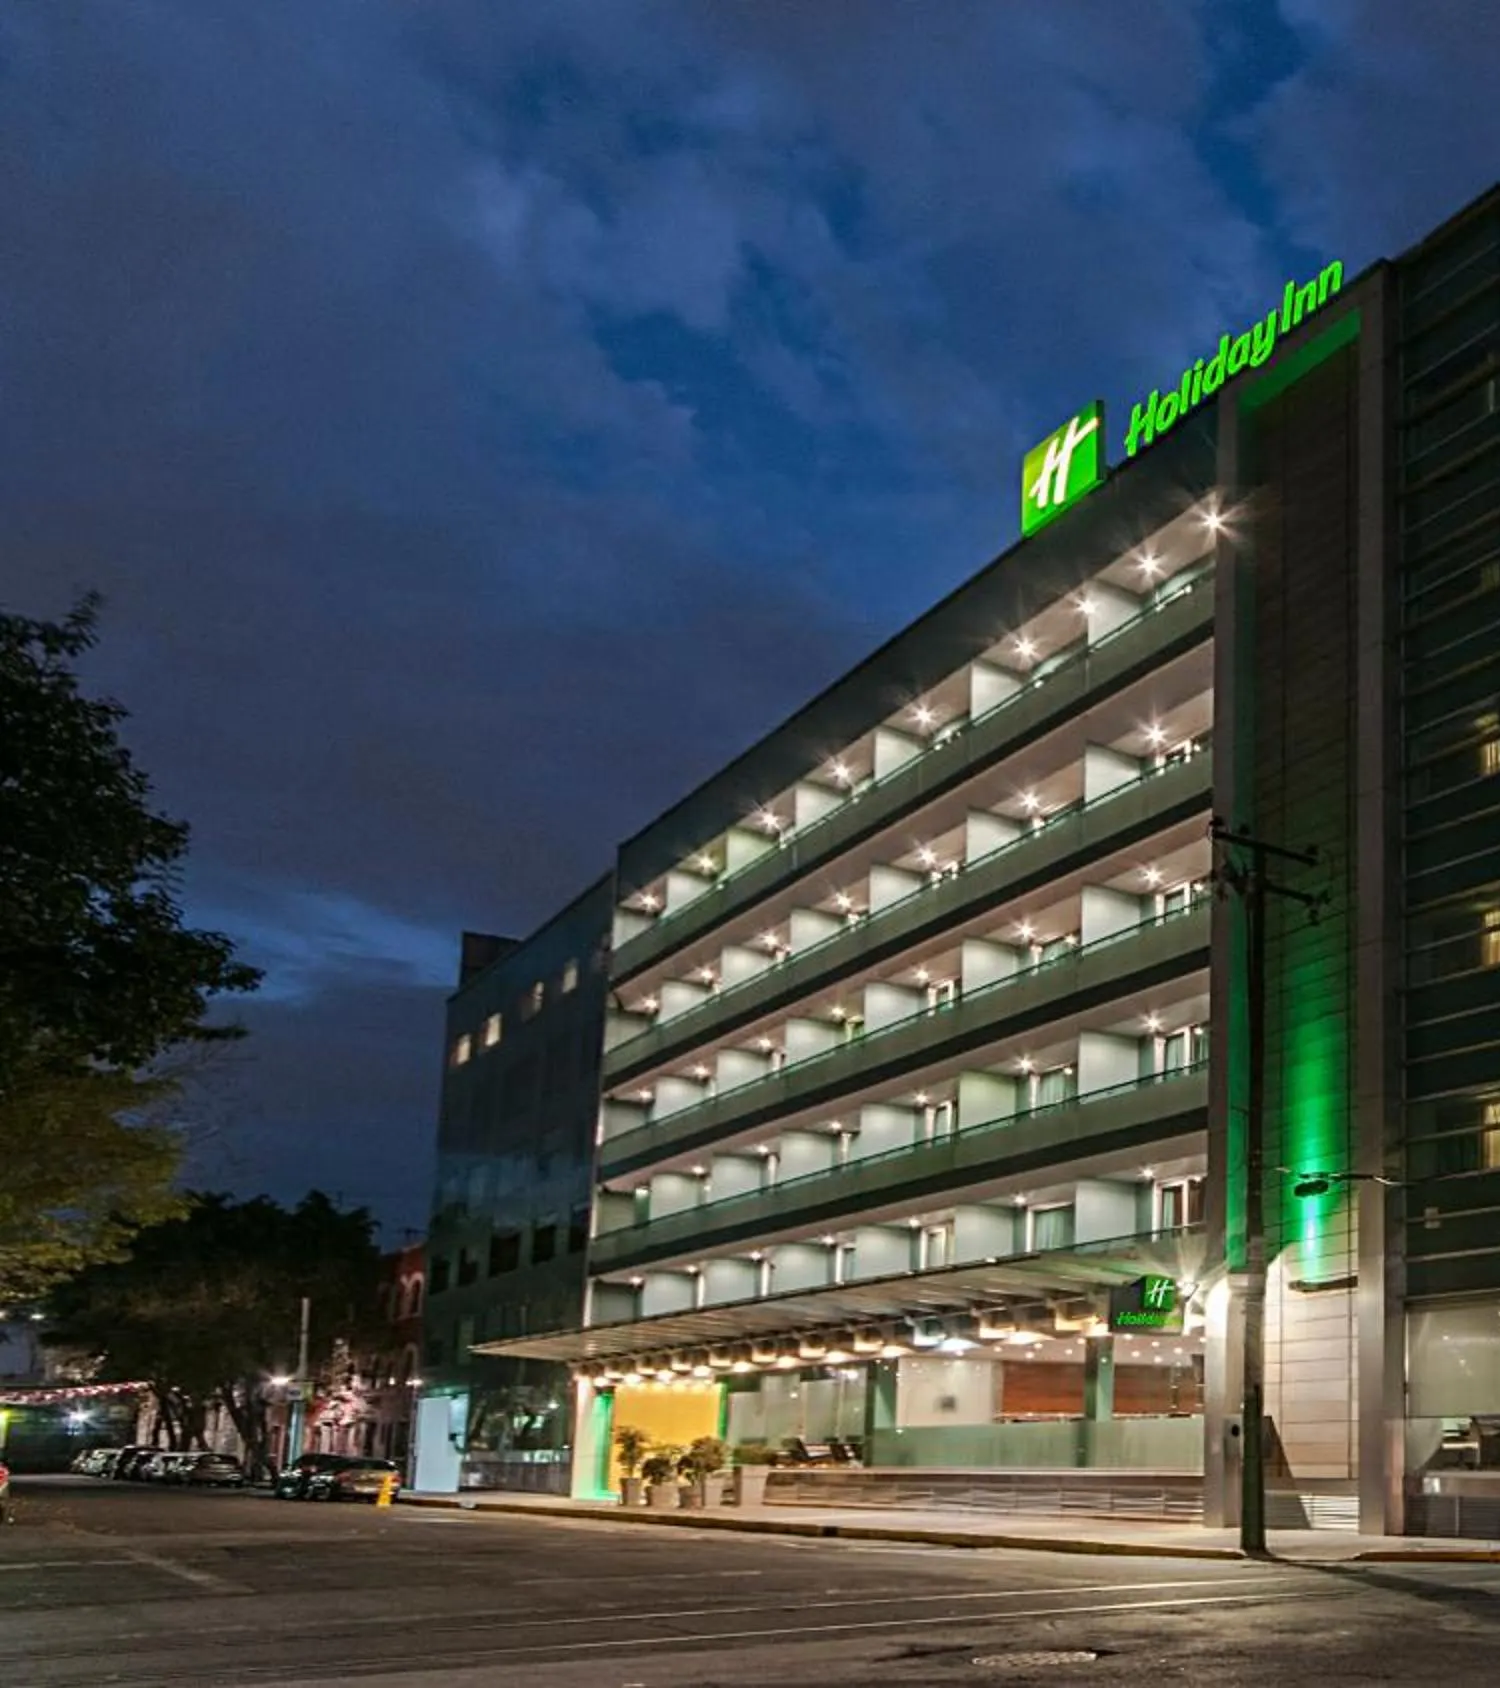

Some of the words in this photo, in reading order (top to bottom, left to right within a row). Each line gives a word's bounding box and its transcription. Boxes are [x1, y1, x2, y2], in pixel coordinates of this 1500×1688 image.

[1124, 308, 1277, 457] Holiday
[1281, 260, 1344, 333] Inn
[1028, 416, 1100, 508] H
